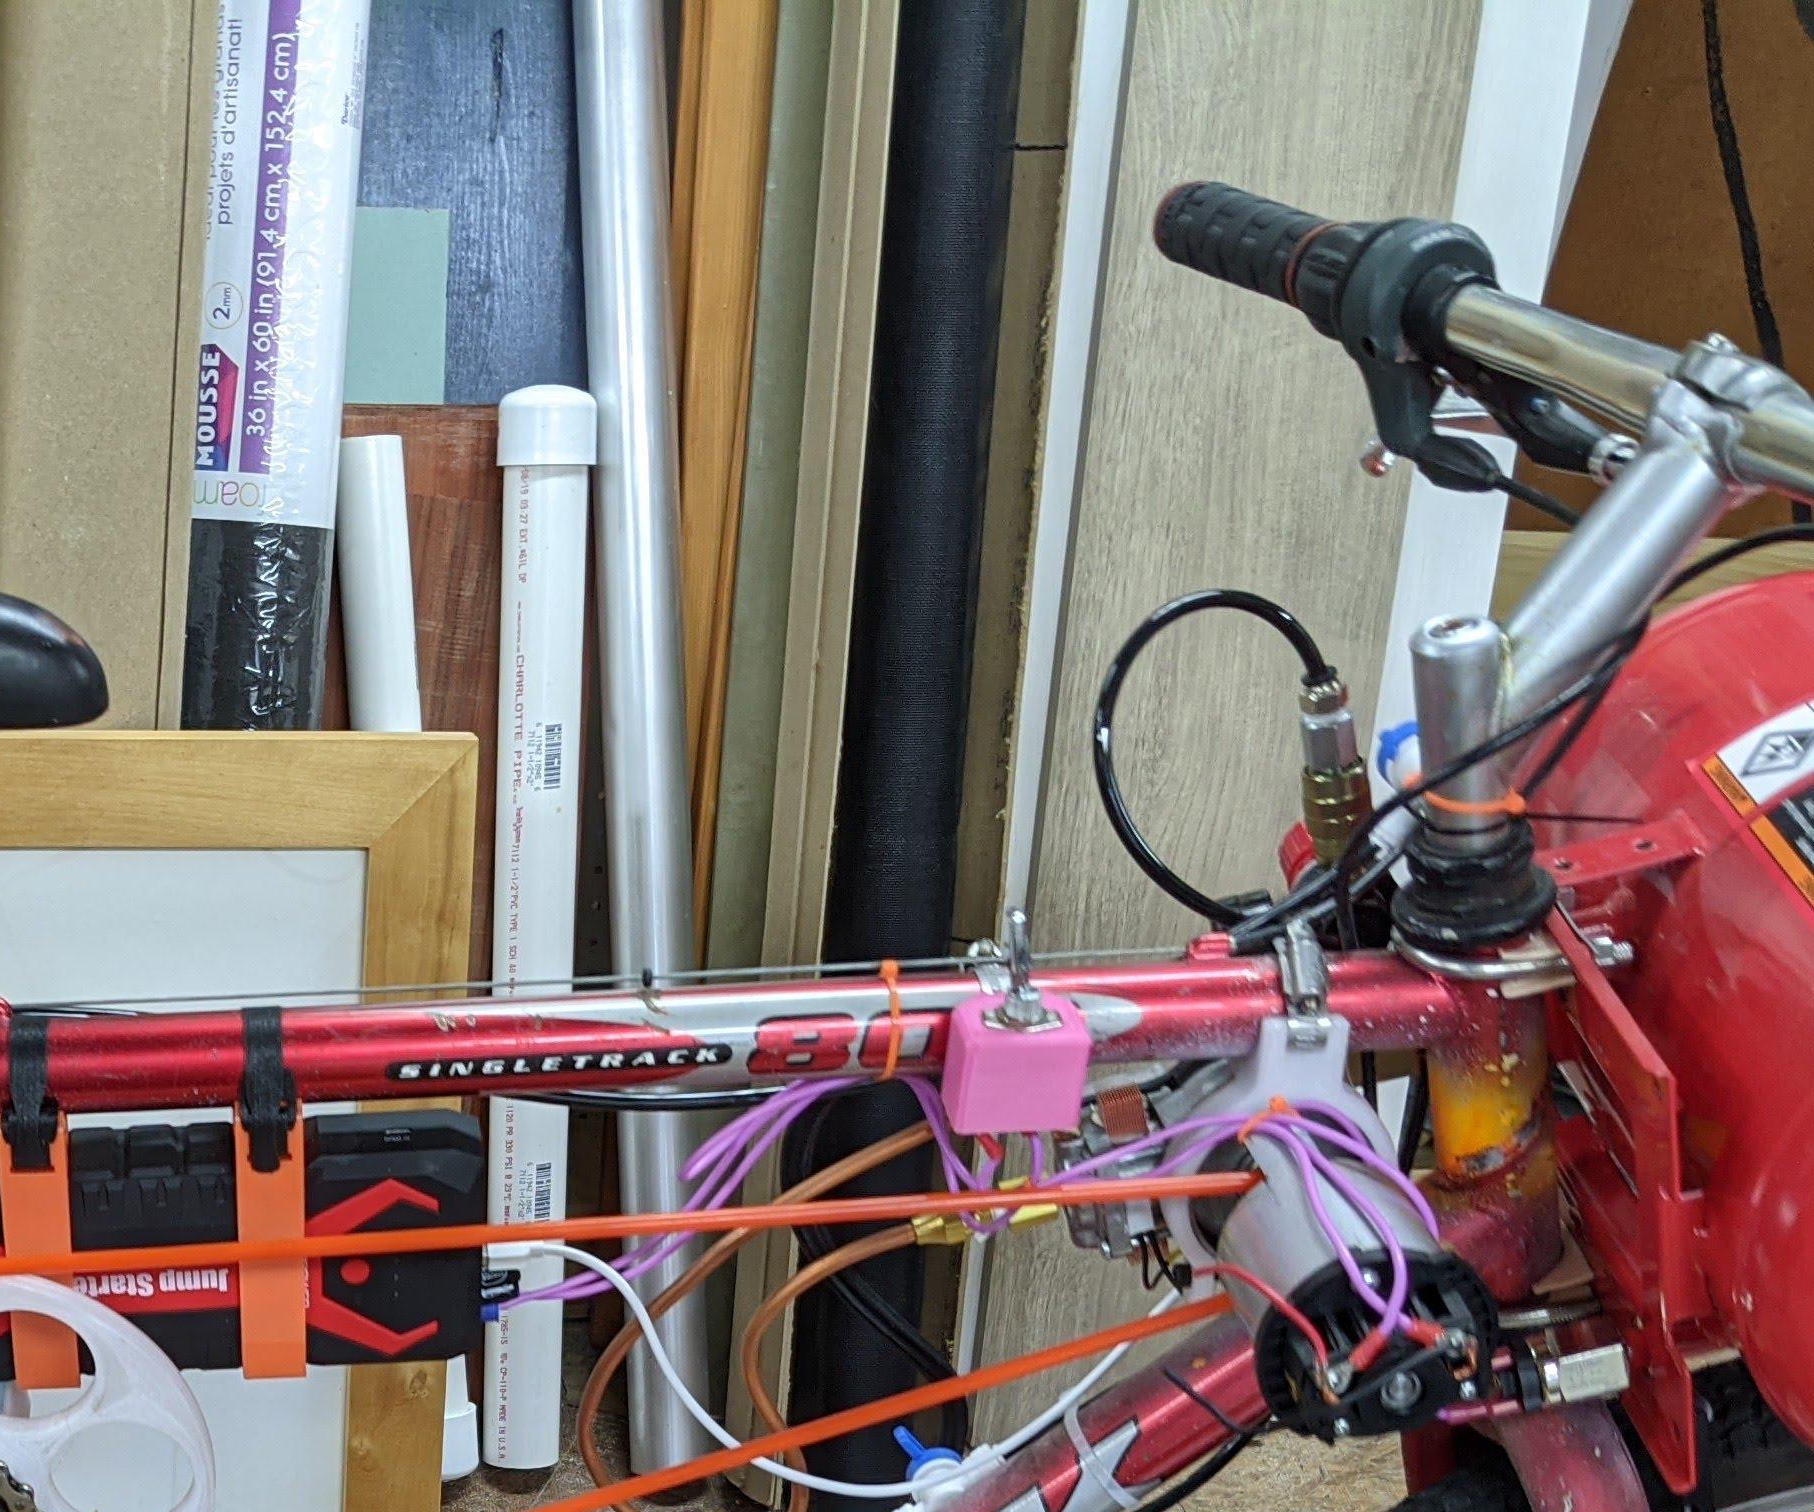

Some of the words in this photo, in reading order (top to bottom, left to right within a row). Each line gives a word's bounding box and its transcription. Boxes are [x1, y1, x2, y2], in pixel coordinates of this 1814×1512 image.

[272, 31, 296, 81] cm)
[264, 87, 289, 152] 152.4
[218, 152, 236, 225] projets
[254, 292, 274, 316] in
[252, 322, 273, 353] 60
[253, 359, 271, 373] x
[248, 380, 269, 402] in
[195, 350, 221, 467] MOUSSE
[246, 408, 266, 437] 36
[514, 654, 525, 741] CHARLOTTE
[513, 749, 522, 788] PIPE
[397, 1044, 721, 1080] SINGLETRACK
[72, 1272, 155, 1298] Starte
[158, 1267, 229, 1293] Jump
